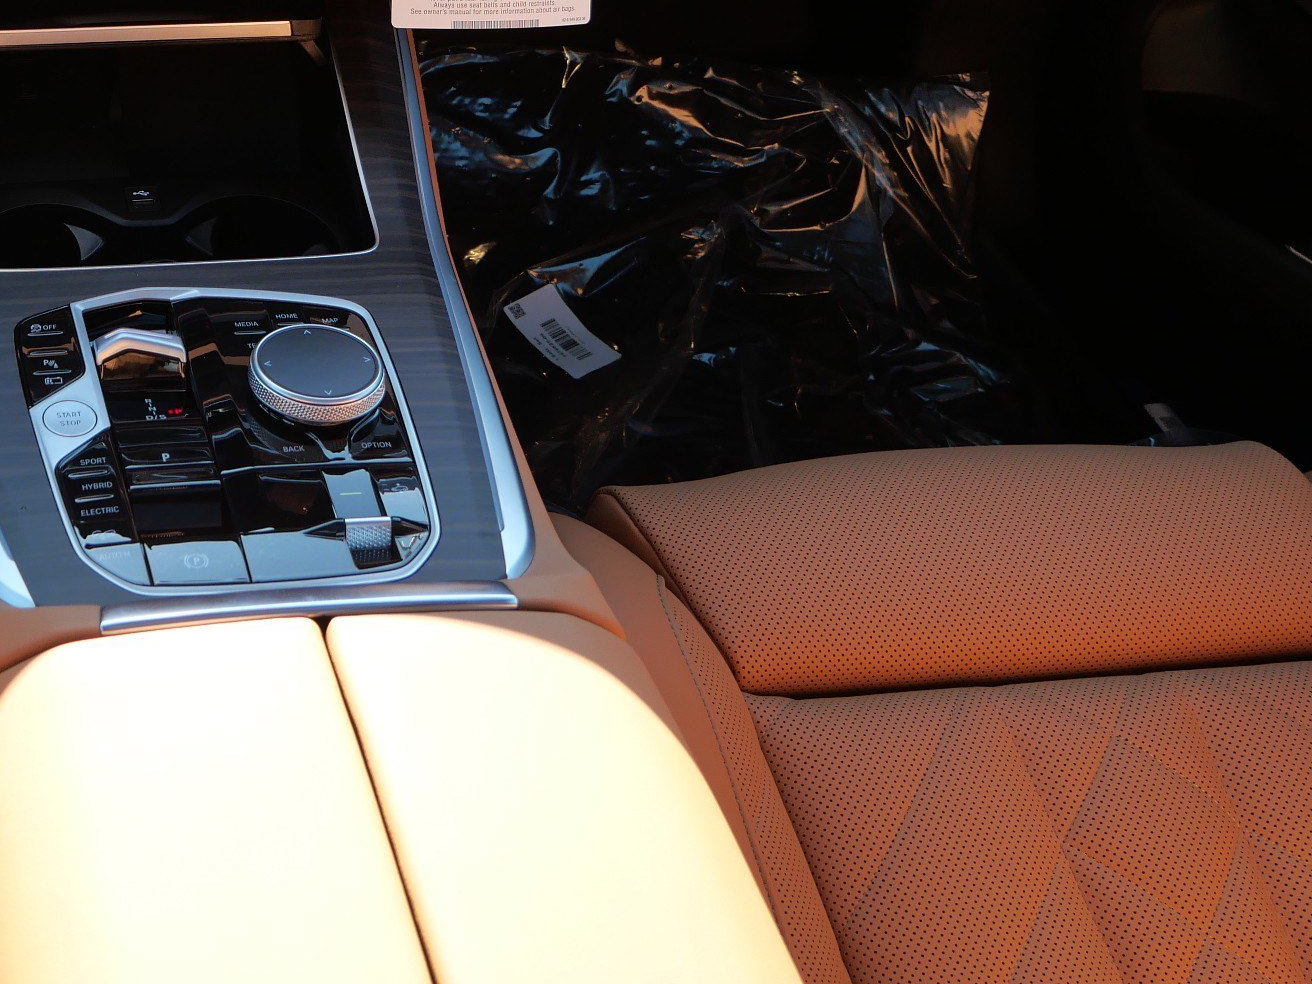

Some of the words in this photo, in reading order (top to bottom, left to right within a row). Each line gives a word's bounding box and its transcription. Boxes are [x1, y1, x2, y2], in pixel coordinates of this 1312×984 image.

[234, 320, 259, 328] MEDIA
[59, 419, 82, 427] STOP
[282, 444, 306, 453] BACK
[361, 441, 392, 449] OPTION
[79, 456, 107, 466] SPORT
[161, 452, 170, 462] P
[81, 481, 113, 491] HYBRID
[80, 505, 120, 517] ELECTRIC
